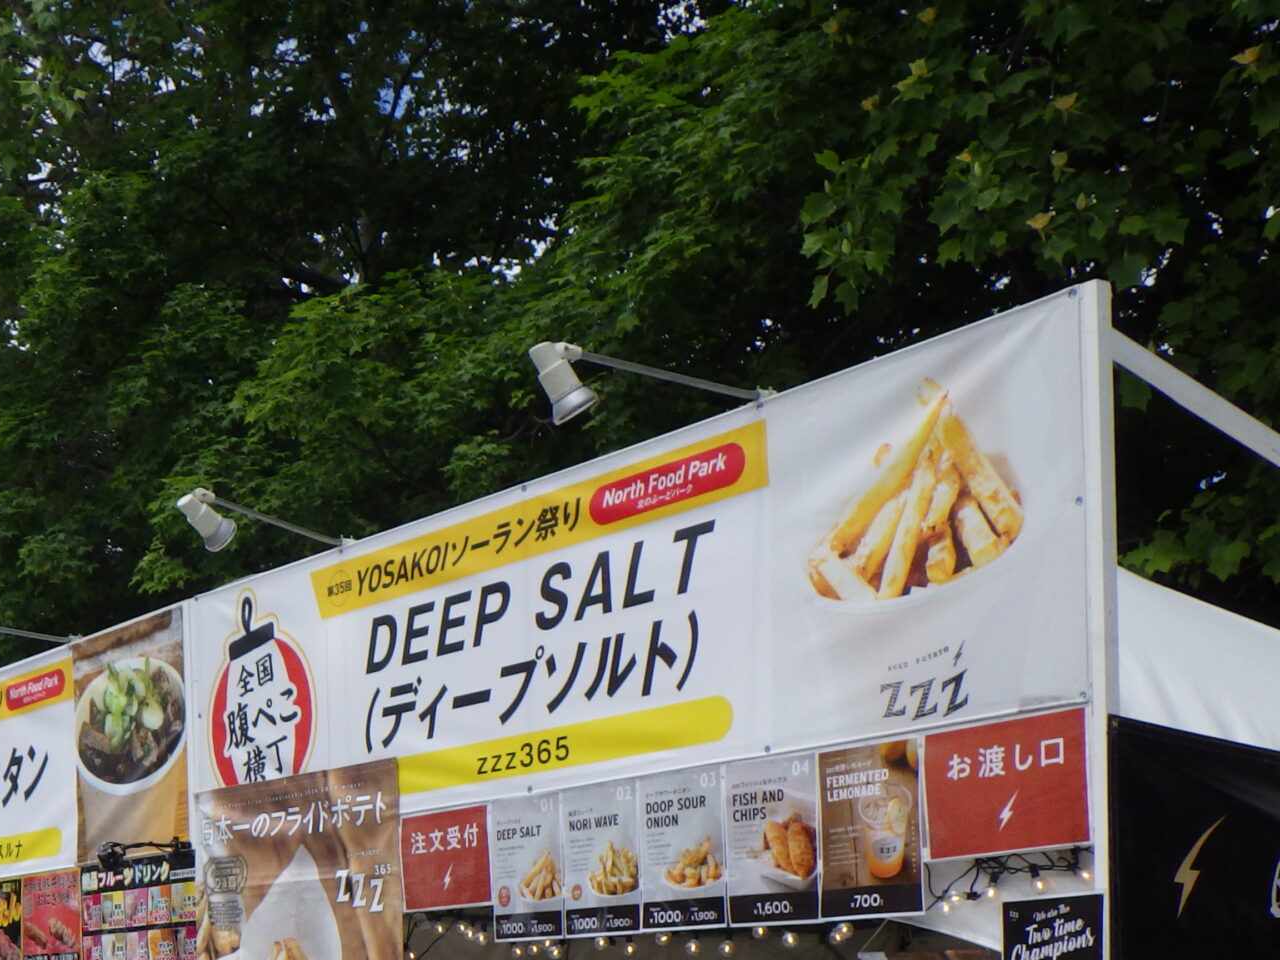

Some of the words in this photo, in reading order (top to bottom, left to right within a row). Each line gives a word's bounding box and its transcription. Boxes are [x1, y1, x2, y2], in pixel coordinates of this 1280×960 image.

[603, 480, 645, 508] North
[648, 467, 686, 497] Food
[688, 453, 727, 481] Park
[327, 581, 353, 597] 第35回
[357, 498, 581, 596] YOSAKOIソーラン祭り
[365, 580, 511, 675] DEEP
[535, 519, 716, 631] SALT
[237, 653, 274, 697] 全国
[365, 609, 699, 754] (ディープソルト)
[227, 688, 298, 750] 腹ぺこ
[243, 736, 287, 784] 横丁
[477, 736, 570, 776] zzz365
[946, 738, 1064, 780] お渡し口
[791, 761, 810, 776] 04
[826, 768, 889, 789] FERMENTED
[699, 771, 716, 788] 03
[616, 786, 632, 801] 02
[733, 792, 758, 807] FISH
[761, 789, 785, 804] AND
[826, 783, 882, 802] LEMONADE
[645, 799, 674, 815] DOOP
[677, 795, 706, 811] SOUR
[733, 807, 767, 822] CHIPS
[201, 791, 387, 847] 日本一のフライドポテト
[569, 817, 592, 832] NORI
[594, 813, 620, 829] WAVE
[646, 814, 679, 829] ONION
[410, 823, 480, 855] 注文受付
[497, 828, 518, 841] DEEP
[520, 825, 542, 838] SALT
[374, 864, 392, 876] 365
[1053, 917, 1084, 937] time
